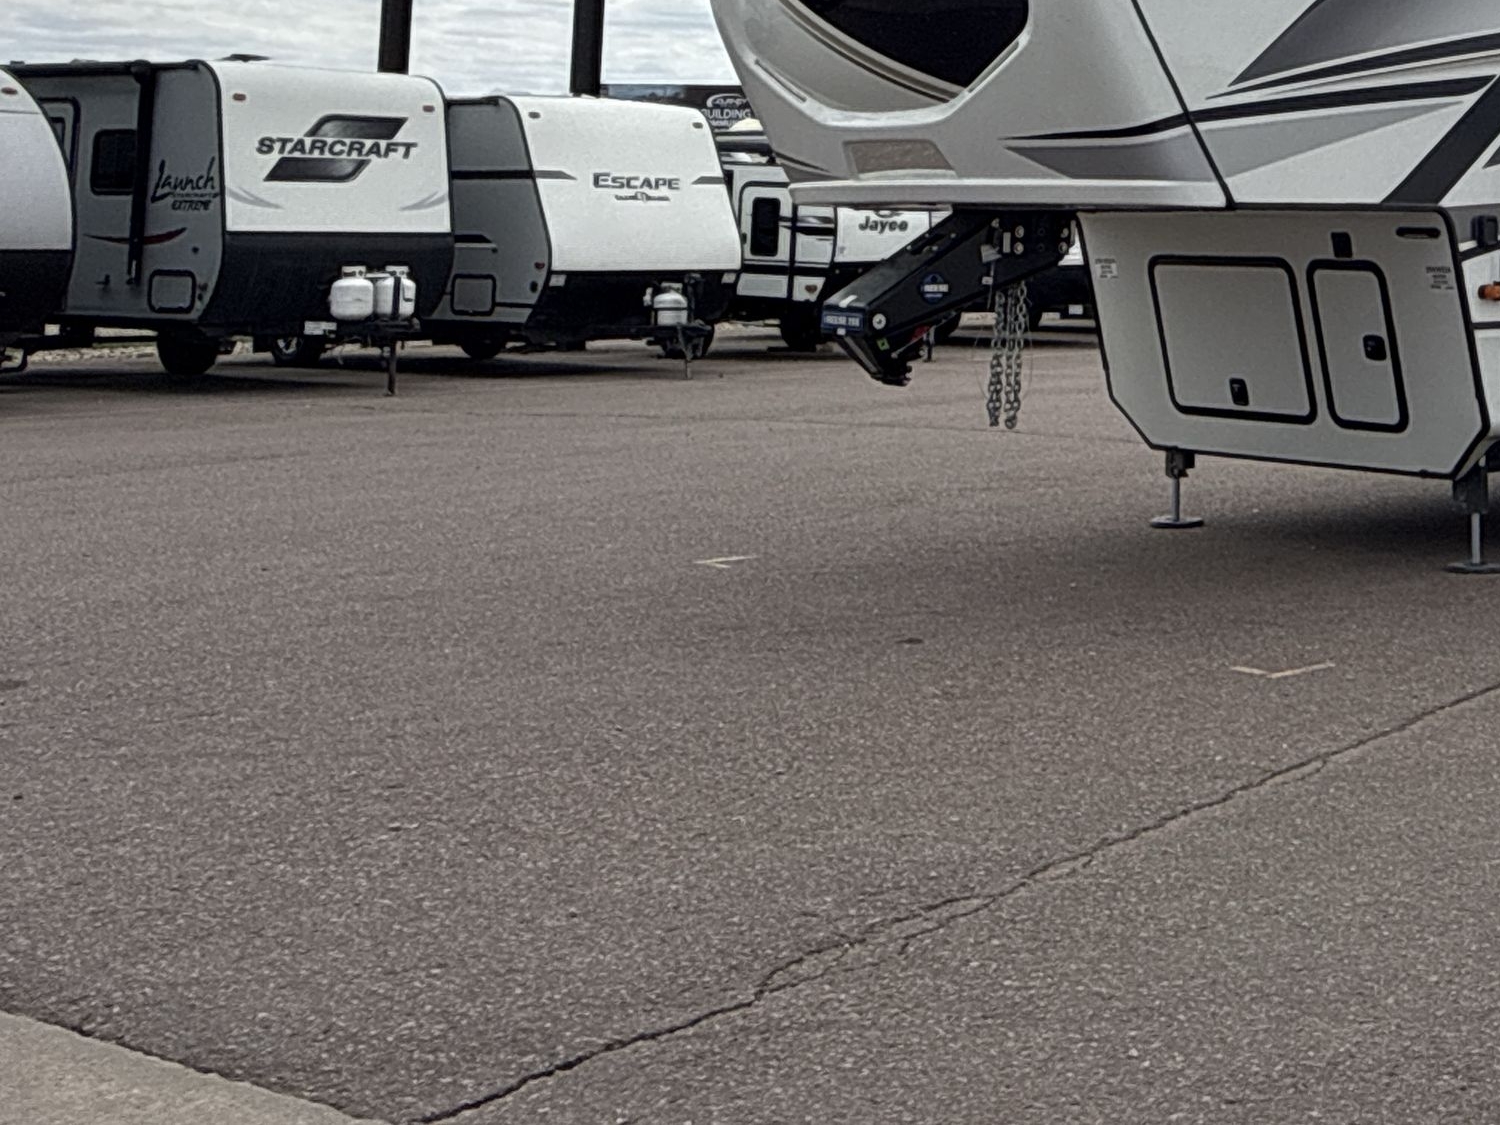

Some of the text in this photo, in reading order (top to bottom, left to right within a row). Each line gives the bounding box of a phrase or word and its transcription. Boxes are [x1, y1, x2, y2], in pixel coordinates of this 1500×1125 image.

[255, 136, 419, 160] STARCRAFT
[151, 156, 219, 203] Launch
[858, 215, 909, 235] Jayco
